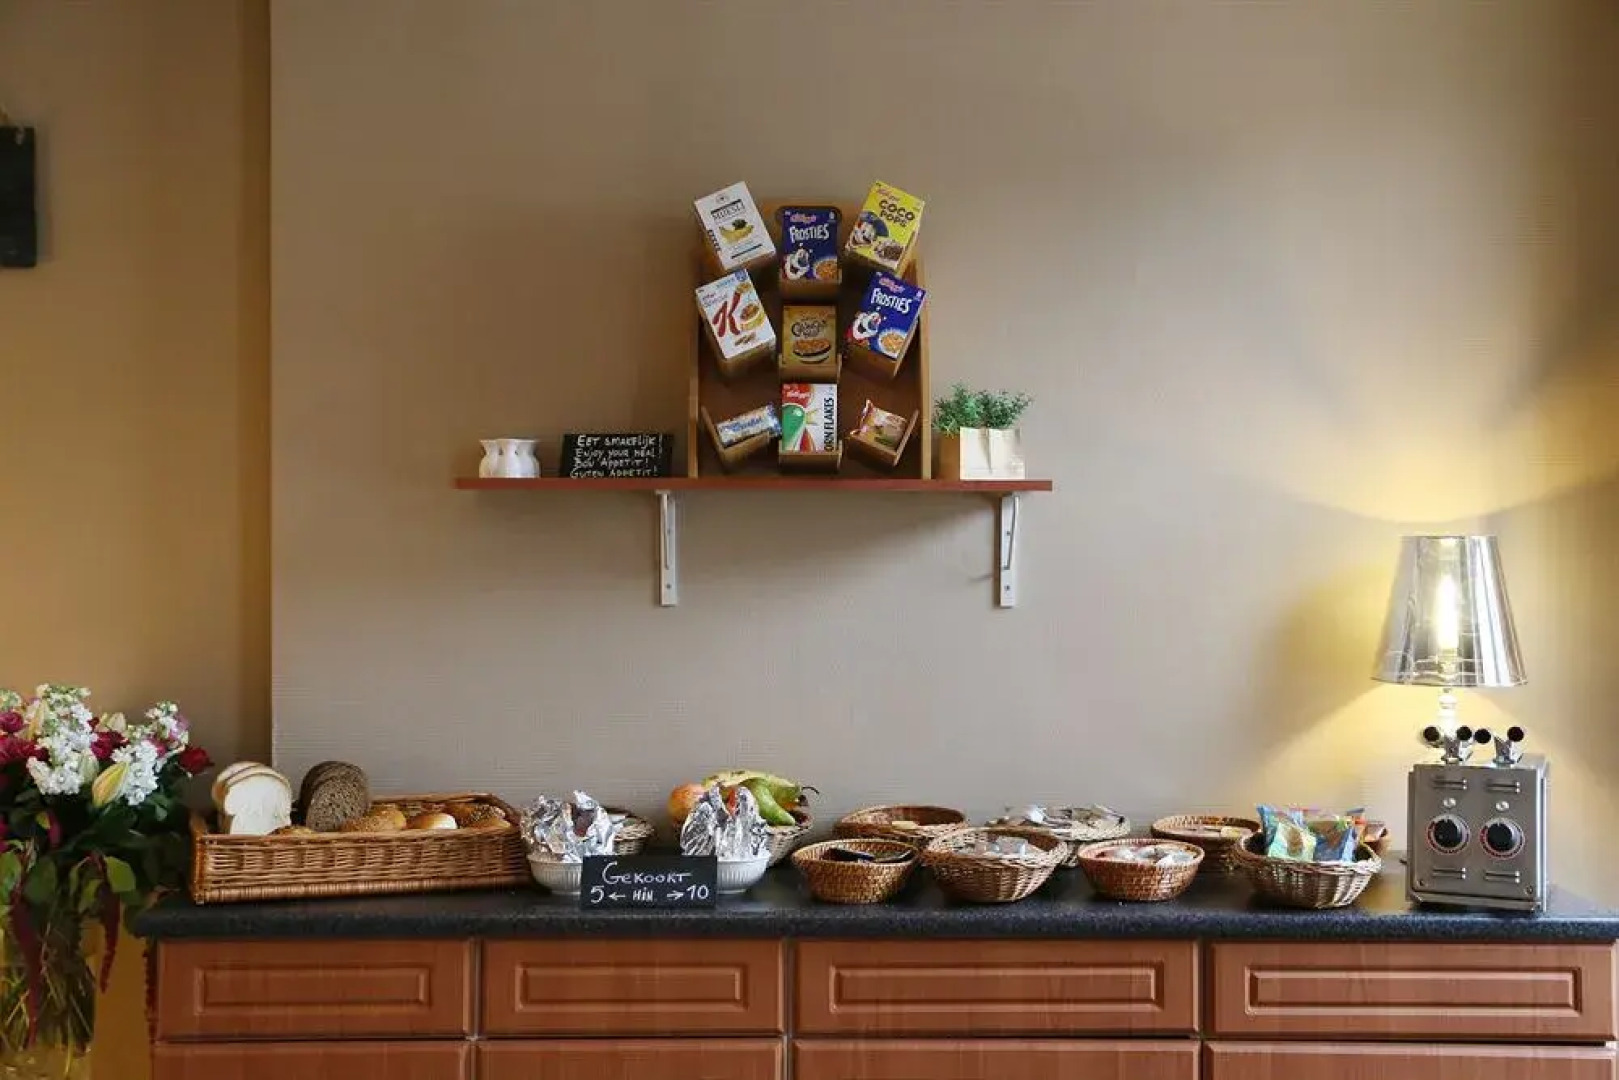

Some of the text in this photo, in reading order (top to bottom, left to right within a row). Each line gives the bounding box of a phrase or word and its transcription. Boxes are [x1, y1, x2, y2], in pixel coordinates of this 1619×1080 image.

[879, 200, 915, 221] COCO
[880, 210, 907, 228] POPS
[789, 223, 830, 243] FROSTIES
[871, 287, 912, 315] FROSTIES
[712, 291, 742, 337] K
[823, 397, 835, 452] ORN FLAKES
[577, 435, 600, 447] EET
[608, 449, 629, 459] YOUR
[570, 467, 605, 478] GUTEN
[590, 885, 605, 903] 5
[686, 884, 710, 900] 10
